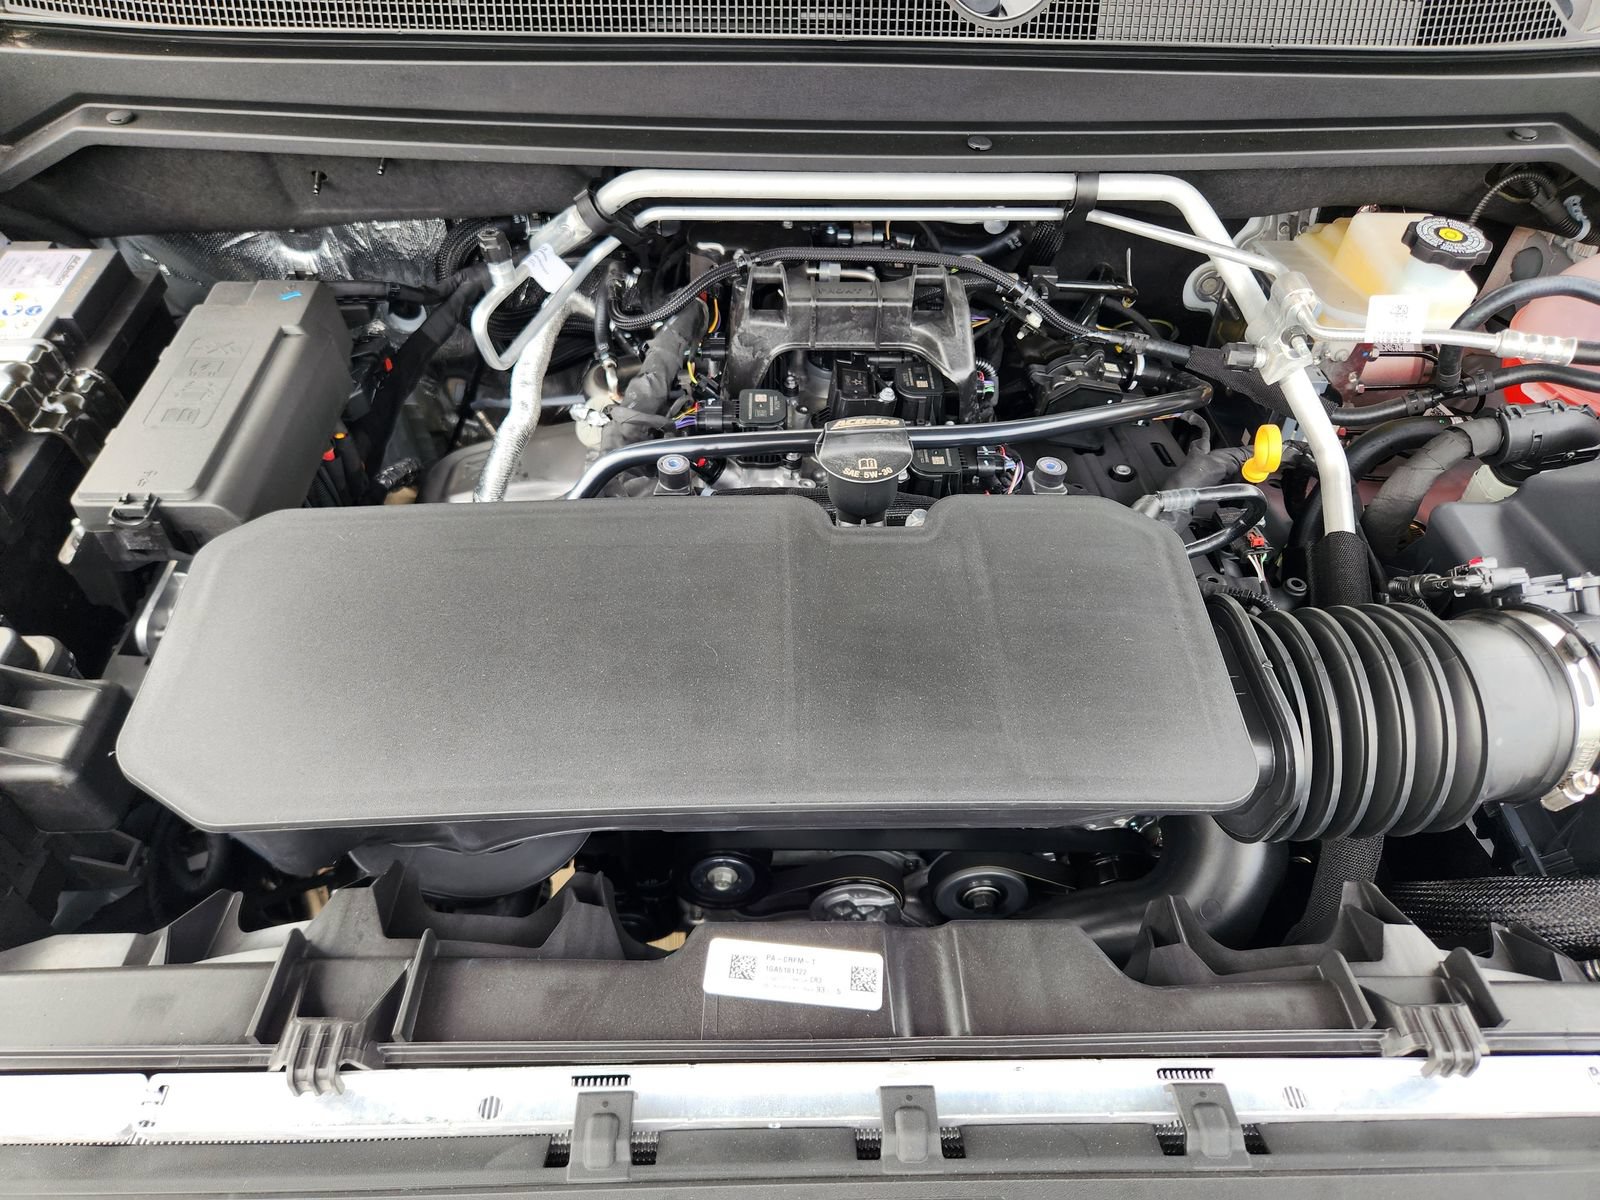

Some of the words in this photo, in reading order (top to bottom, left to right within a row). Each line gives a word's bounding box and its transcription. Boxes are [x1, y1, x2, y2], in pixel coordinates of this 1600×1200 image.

[830, 418, 900, 430] ACDelco
[843, 467, 860, 478] SAE
[863, 467, 893, 479] 5W-30
